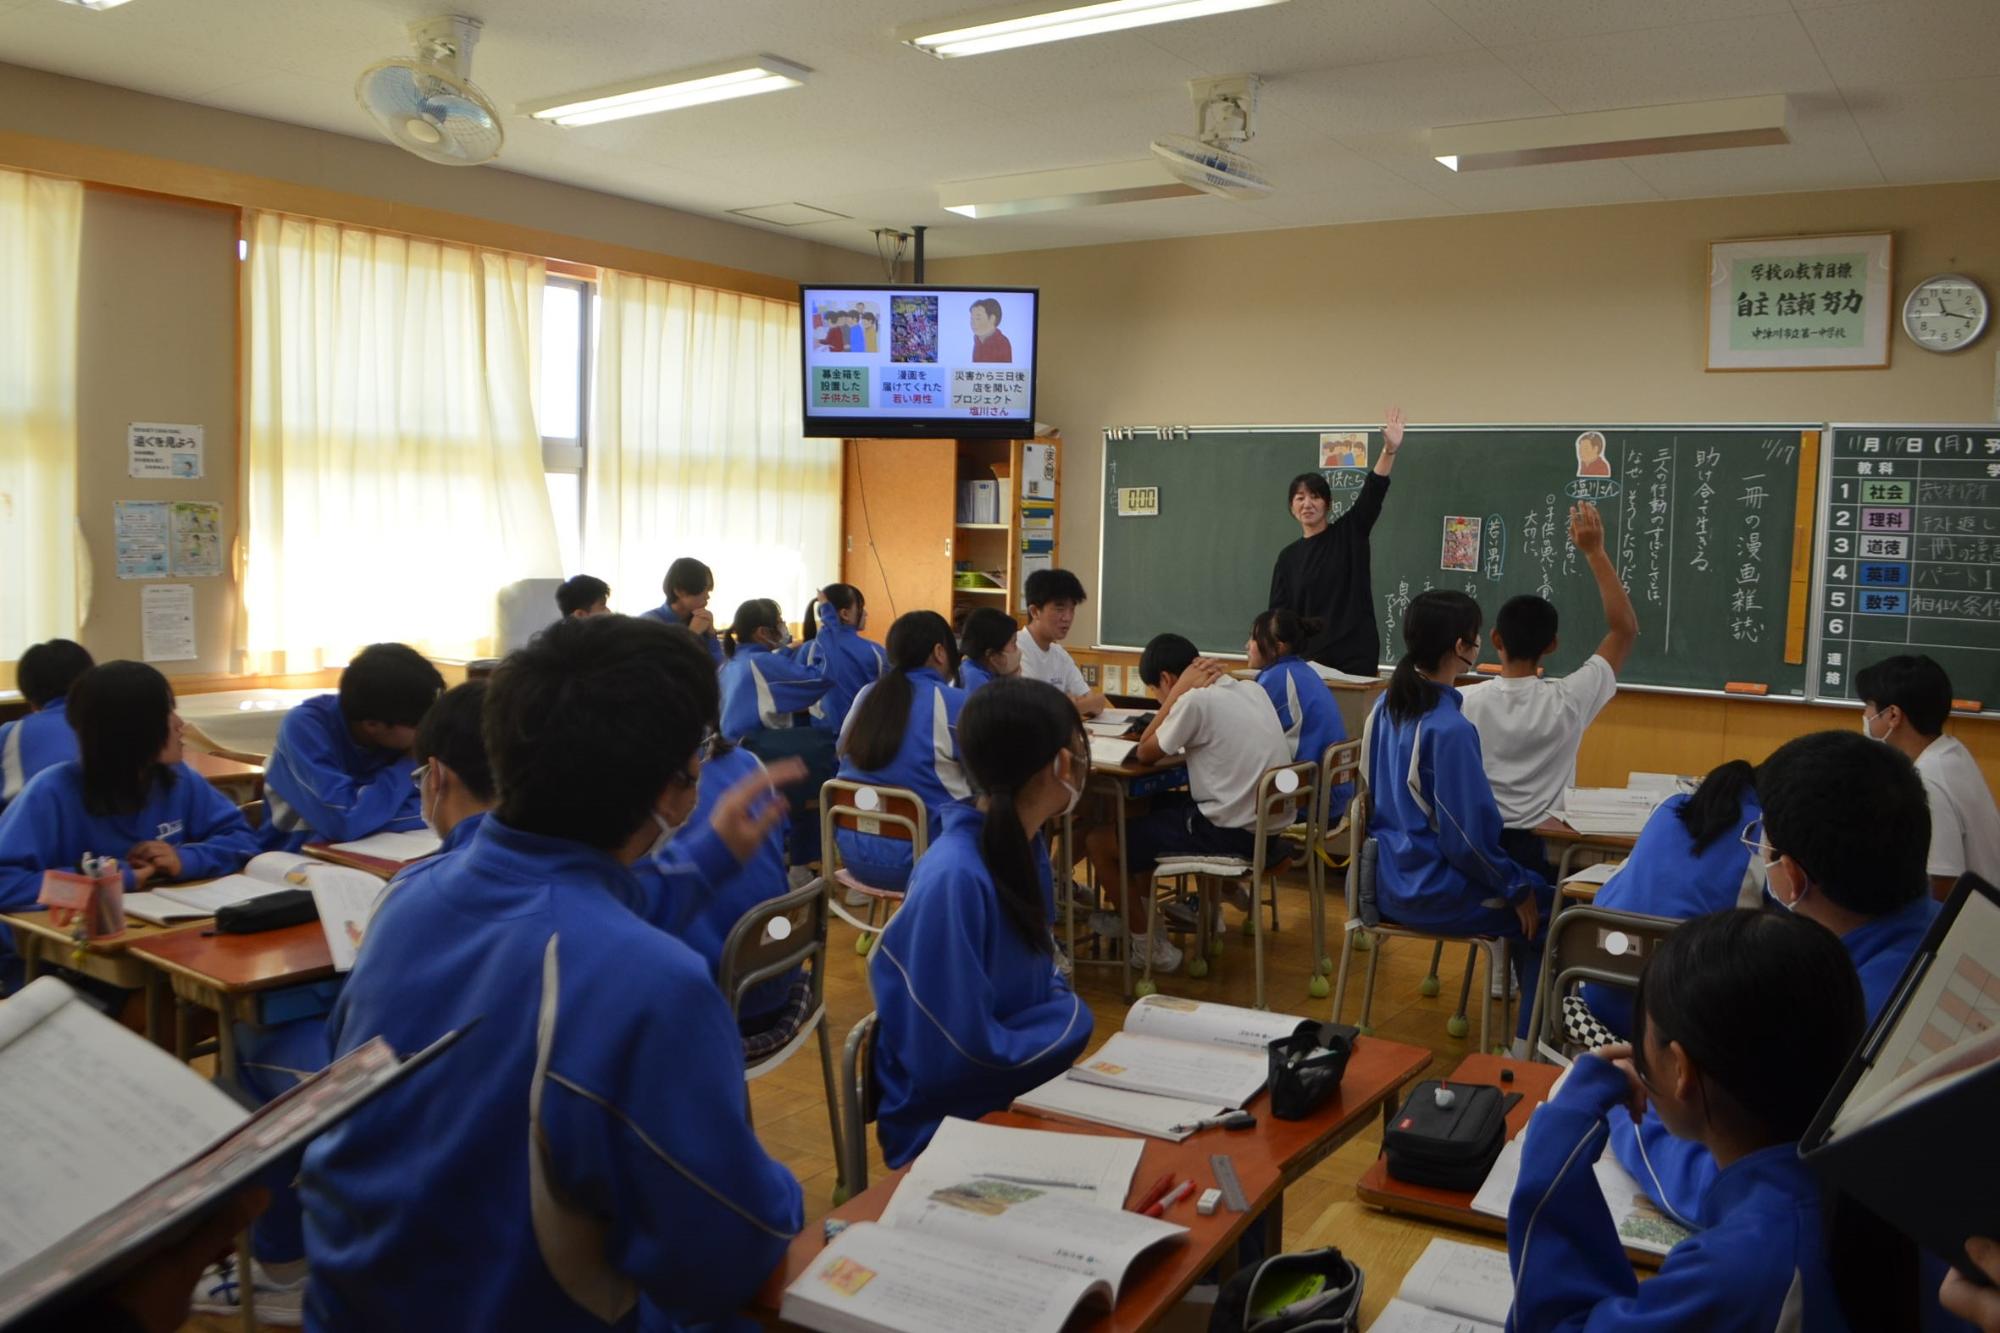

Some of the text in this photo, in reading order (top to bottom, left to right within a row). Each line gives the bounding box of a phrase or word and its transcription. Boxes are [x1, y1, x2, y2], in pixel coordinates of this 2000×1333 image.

[1750, 262, 1852, 281] 学校の教育目標
[1737, 288, 1863, 317] 自主 信頼 努力
[822, 369, 862, 381] 募金箱を
[897, 369, 926, 381] 漫画を
[954, 370, 1025, 382] 災害から三日後
[820, 381, 861, 392] 設置した
[882, 381, 943, 393] 届けてくれた
[972, 382, 1022, 393] 店を開いた
[820, 393, 860, 404] 子供たち
[892, 393, 933, 405] 若い男性
[952, 393, 1012, 405] プロジェクト
[968, 406, 1009, 417] 塩川さん
[1761, 438, 1795, 465] 11/17
[1857, 461, 1895, 476] 教科
[1571, 480, 1619, 498] 塩川さん
[1839, 483, 1849, 499] 1
[1869, 484, 1904, 500] 社会
[1836, 511, 1851, 526] 2
[1868, 512, 1903, 528] 理科
[1486, 519, 1503, 579] 若い男性
[1834, 538, 1850, 554] 3
[1866, 539, 1901, 556] 道徳
[1731, 472, 1769, 643] 一冊の漫画雑誌
[1832, 565, 1848, 580] 4
[1865, 566, 1901, 583] 英語
[1830, 592, 1846, 607] 5
[1865, 594, 1900, 610] 数学
[1828, 618, 1844, 634] 6
